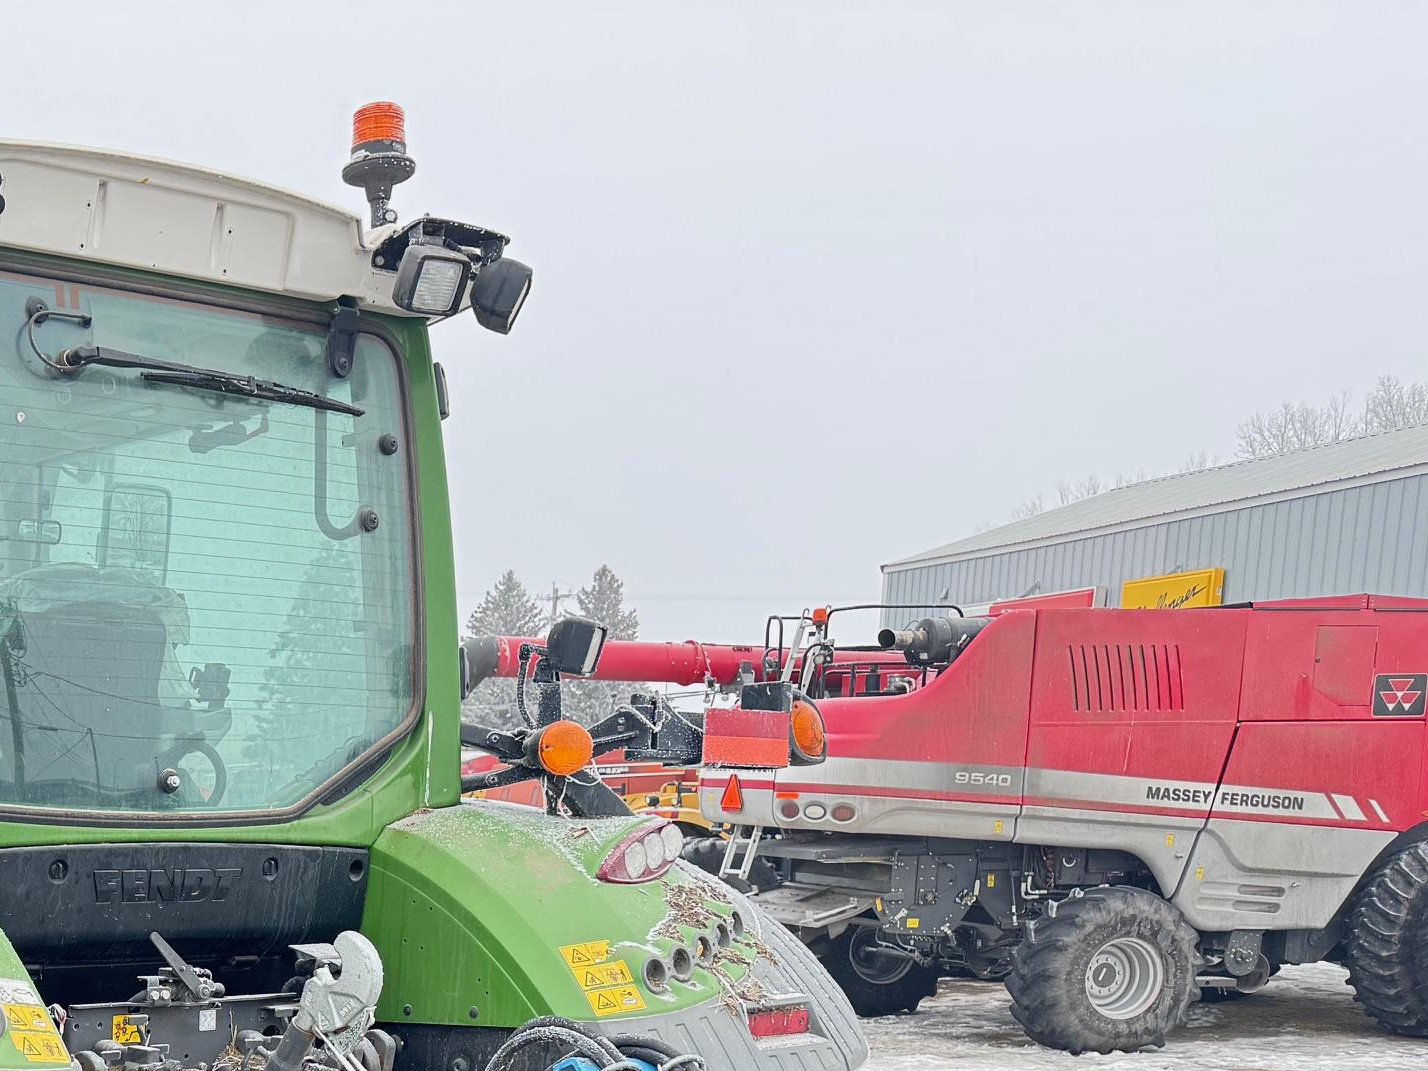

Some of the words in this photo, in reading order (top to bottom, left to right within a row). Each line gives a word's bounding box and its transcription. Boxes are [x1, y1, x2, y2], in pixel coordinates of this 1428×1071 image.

[954, 772, 1011, 787] 9540
[1146, 786, 1212, 804] MASSEY
[1221, 792, 1305, 810] FERGUSON
[93, 869, 243, 904] FENDT
